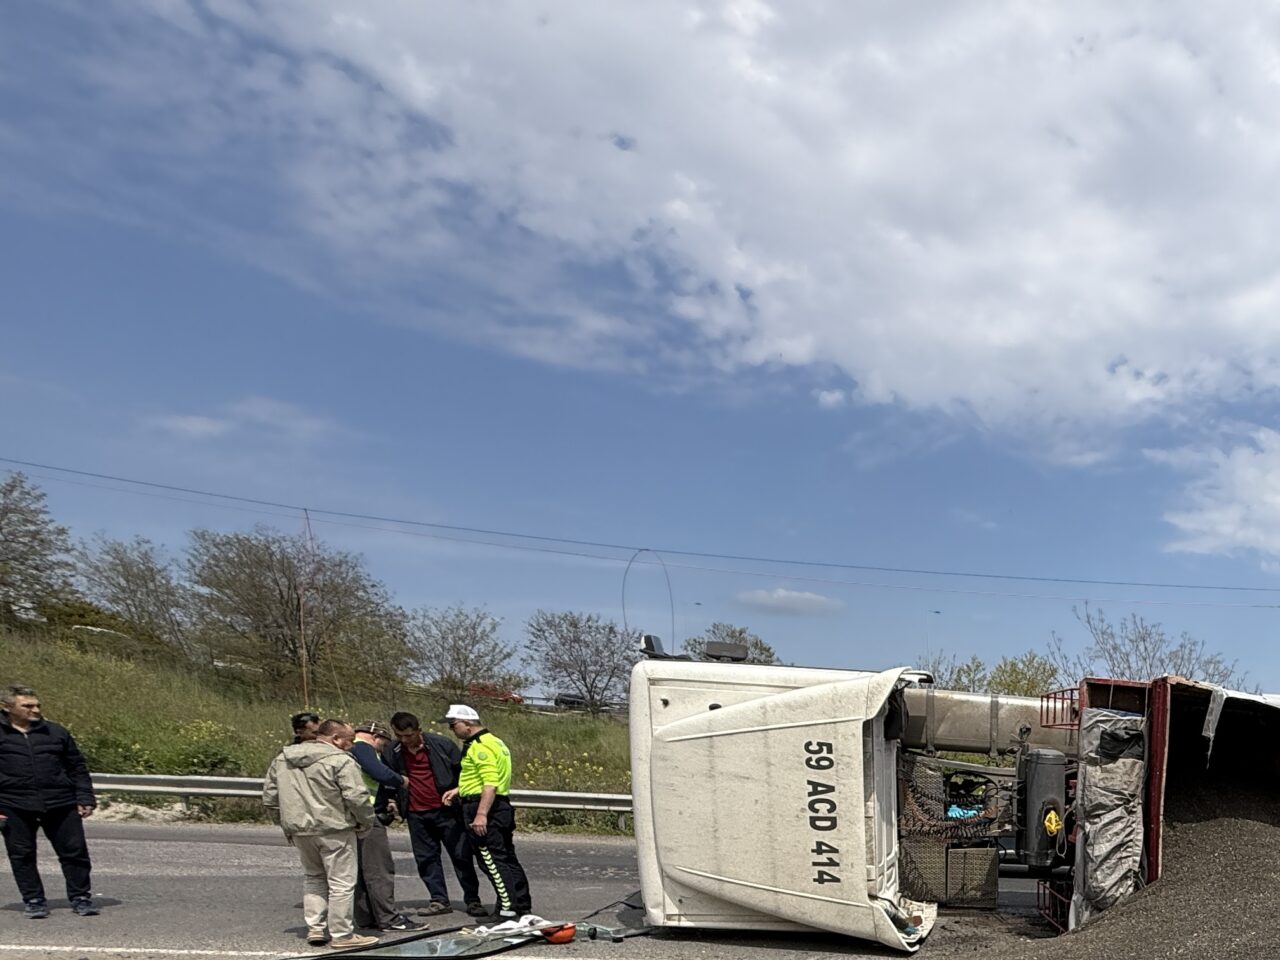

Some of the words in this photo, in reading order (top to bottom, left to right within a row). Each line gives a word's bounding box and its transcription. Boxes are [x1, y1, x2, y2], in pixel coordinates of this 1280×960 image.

[804, 740, 834, 770] 59
[807, 779, 838, 831] ACD
[811, 841, 841, 884] 414
